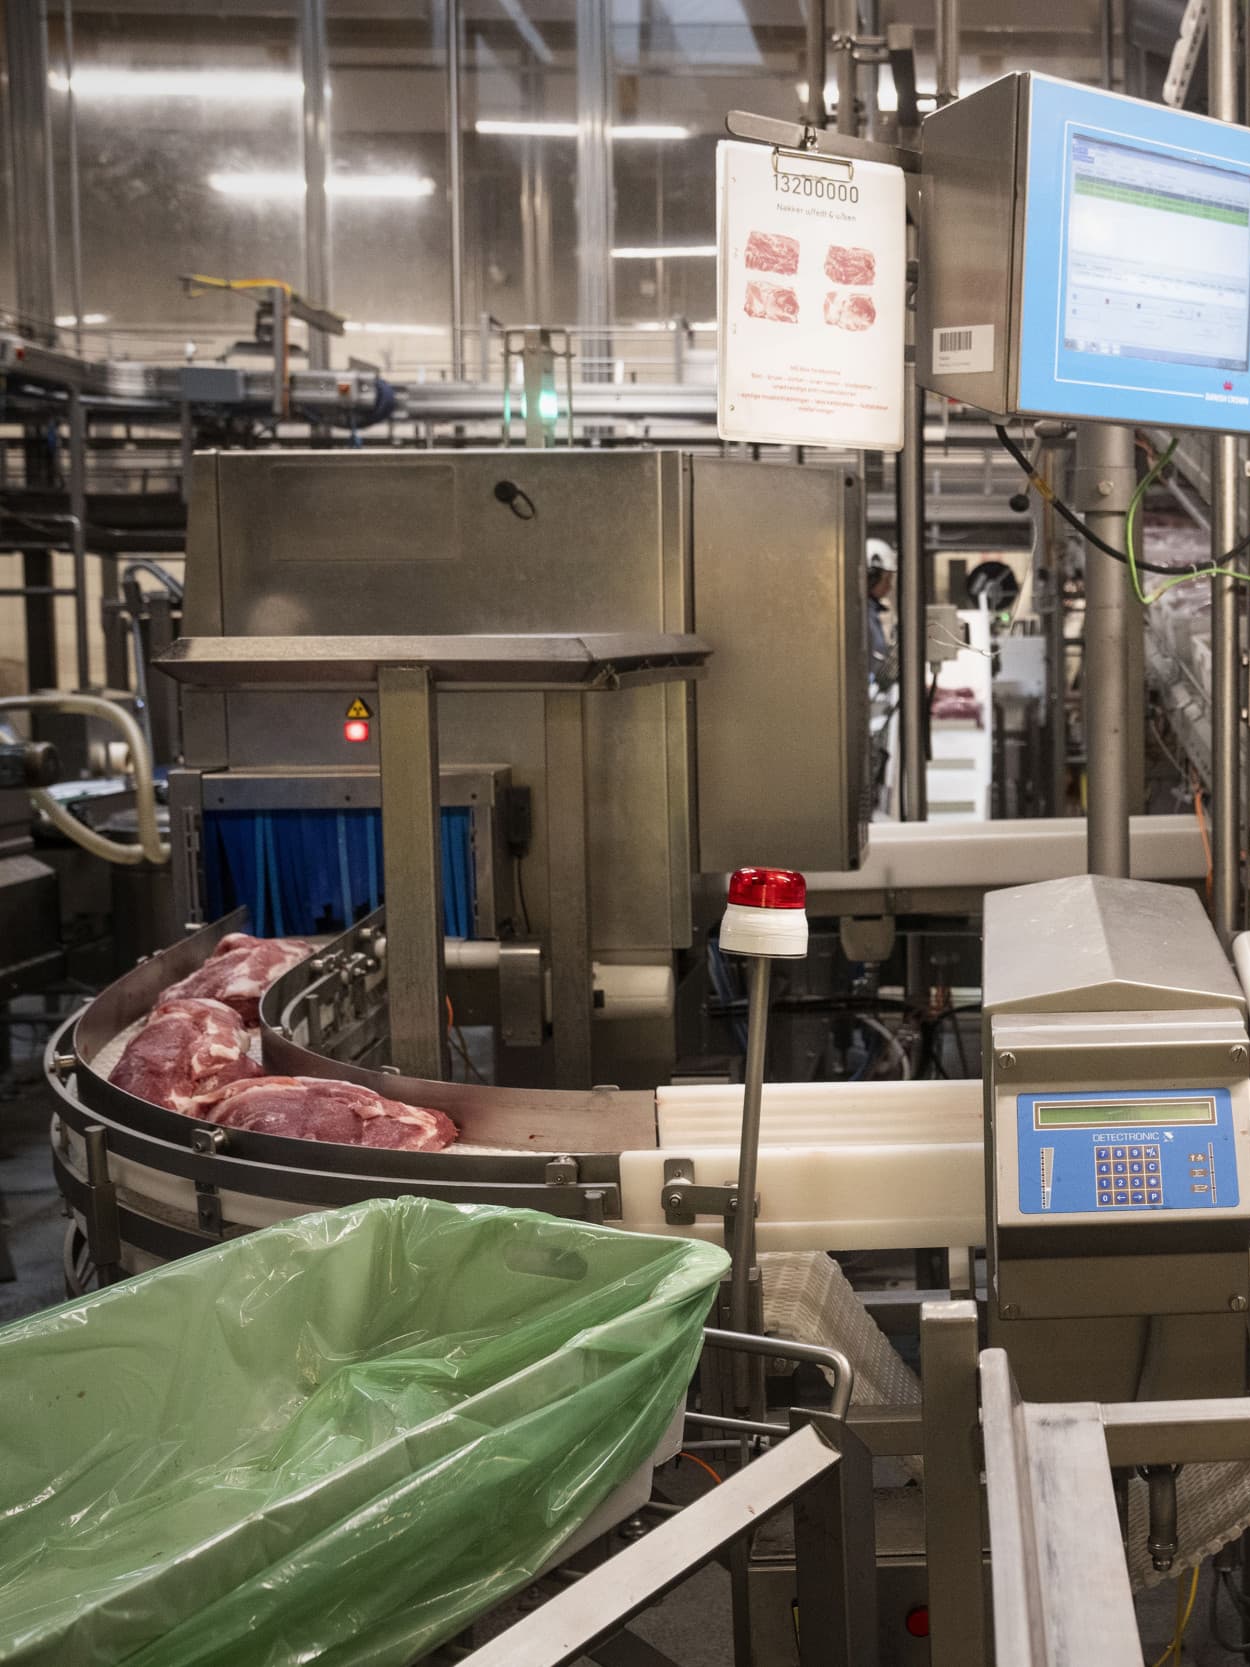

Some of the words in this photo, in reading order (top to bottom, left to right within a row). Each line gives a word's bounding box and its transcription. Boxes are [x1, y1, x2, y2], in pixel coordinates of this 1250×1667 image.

[773, 174, 859, 203] 13200000
[1092, 1131, 1160, 1142] DETECTRONIC
[1148, 1163, 1155, 1171] C
